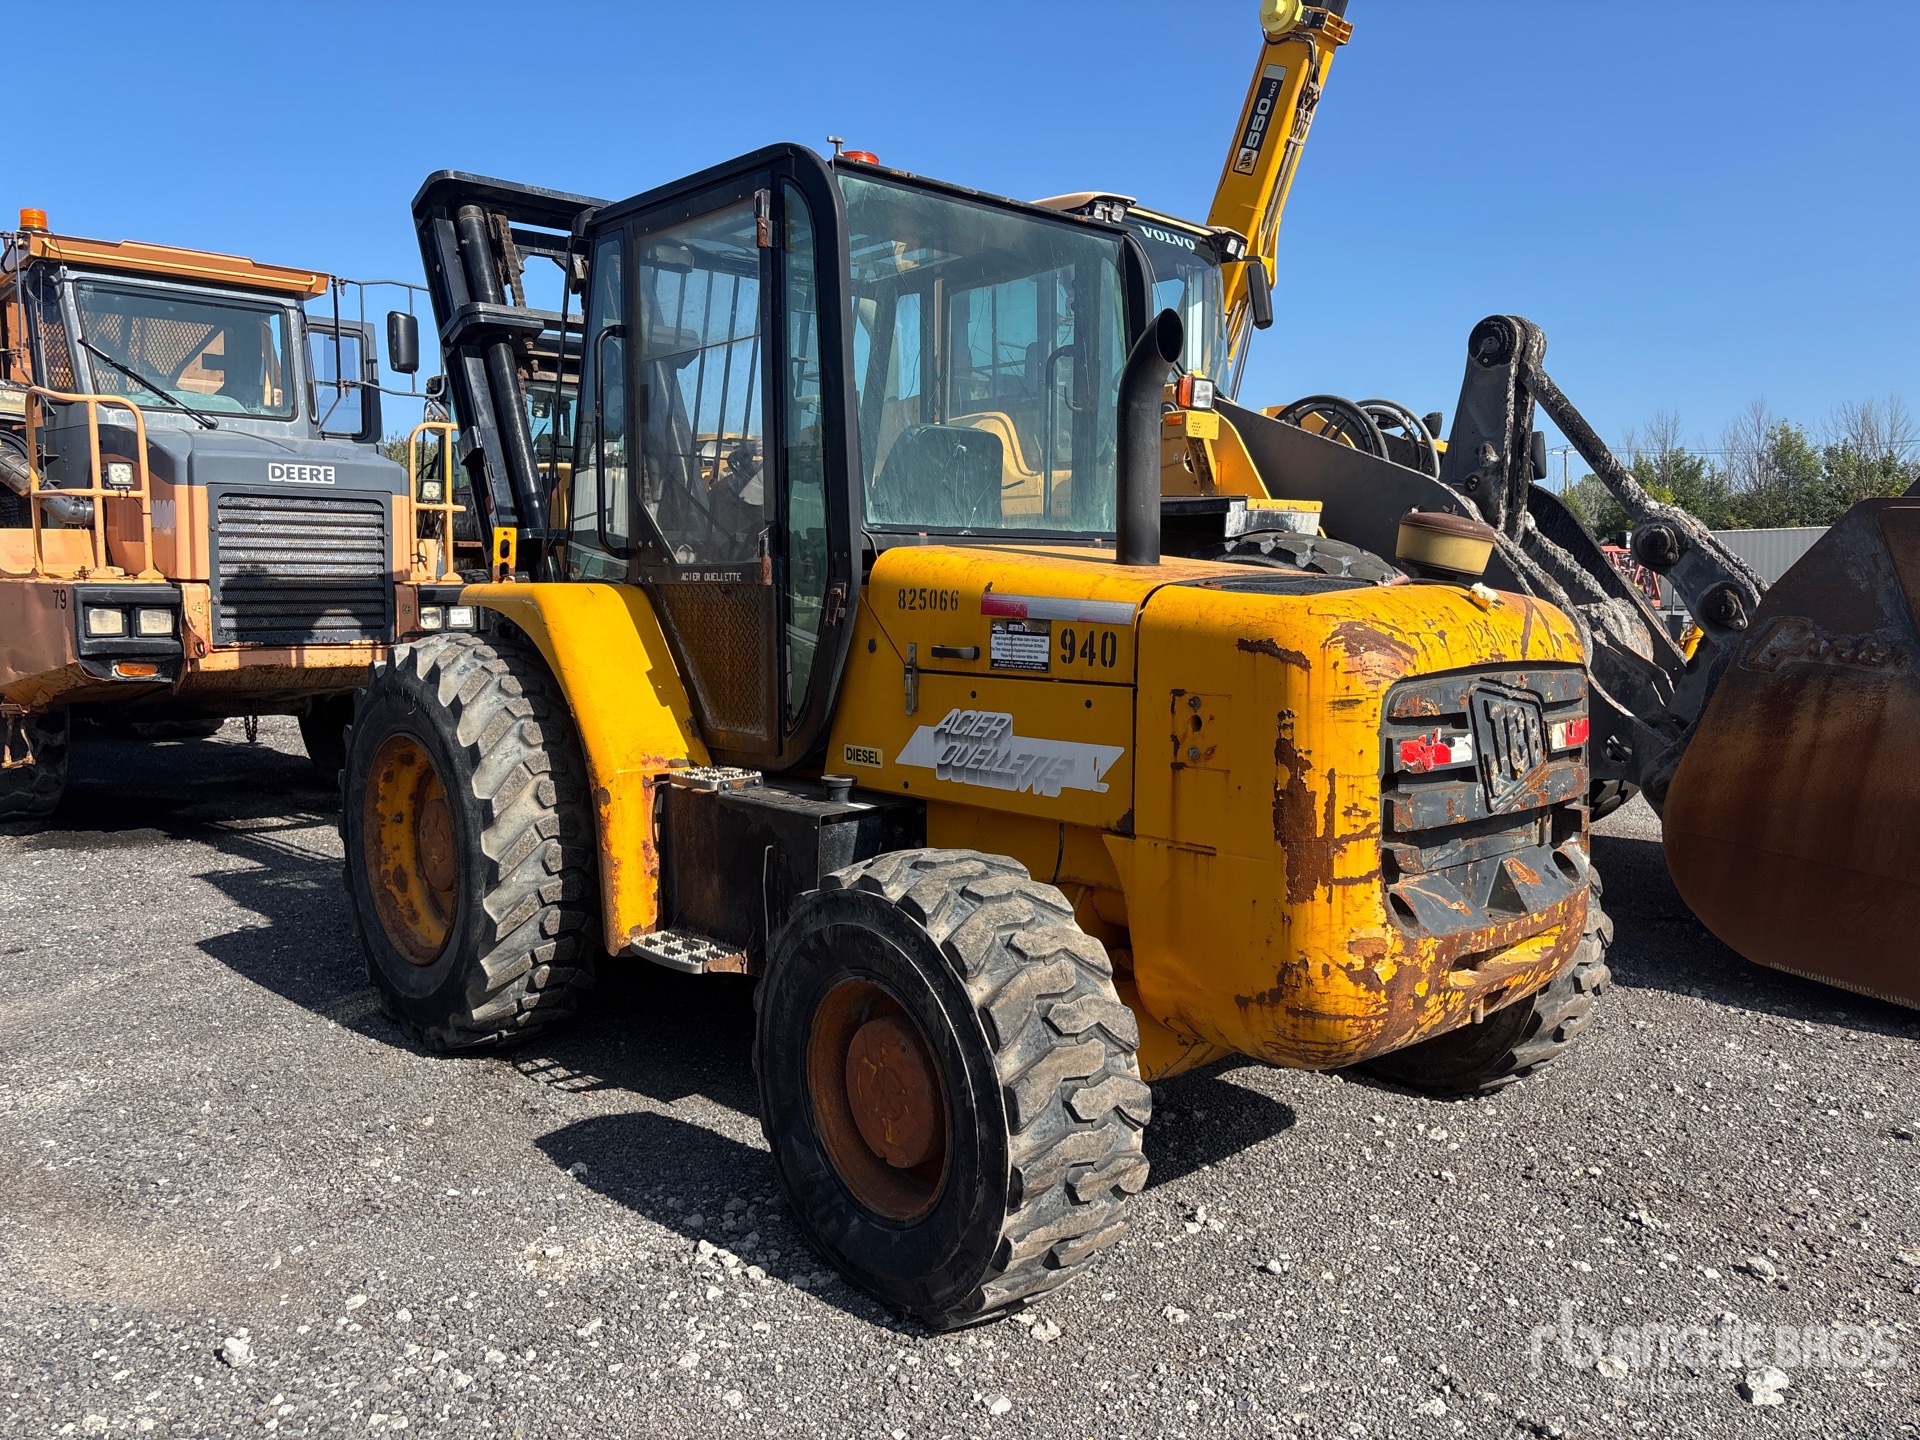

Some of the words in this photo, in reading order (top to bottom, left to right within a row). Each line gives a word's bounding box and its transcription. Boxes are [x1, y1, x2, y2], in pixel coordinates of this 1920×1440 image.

[1246, 98, 1271, 148] 550
[1268, 81, 1277, 98] 140
[1138, 224, 1196, 251] VOLVO
[269, 463, 335, 484] DEERE
[681, 572, 701, 581] ACIER
[52, 589, 67, 610] 79
[897, 588, 959, 611] 825066
[1060, 628, 1117, 668] 940
[934, 708, 1012, 742] ACIER
[846, 747, 881, 765] DIESEL
